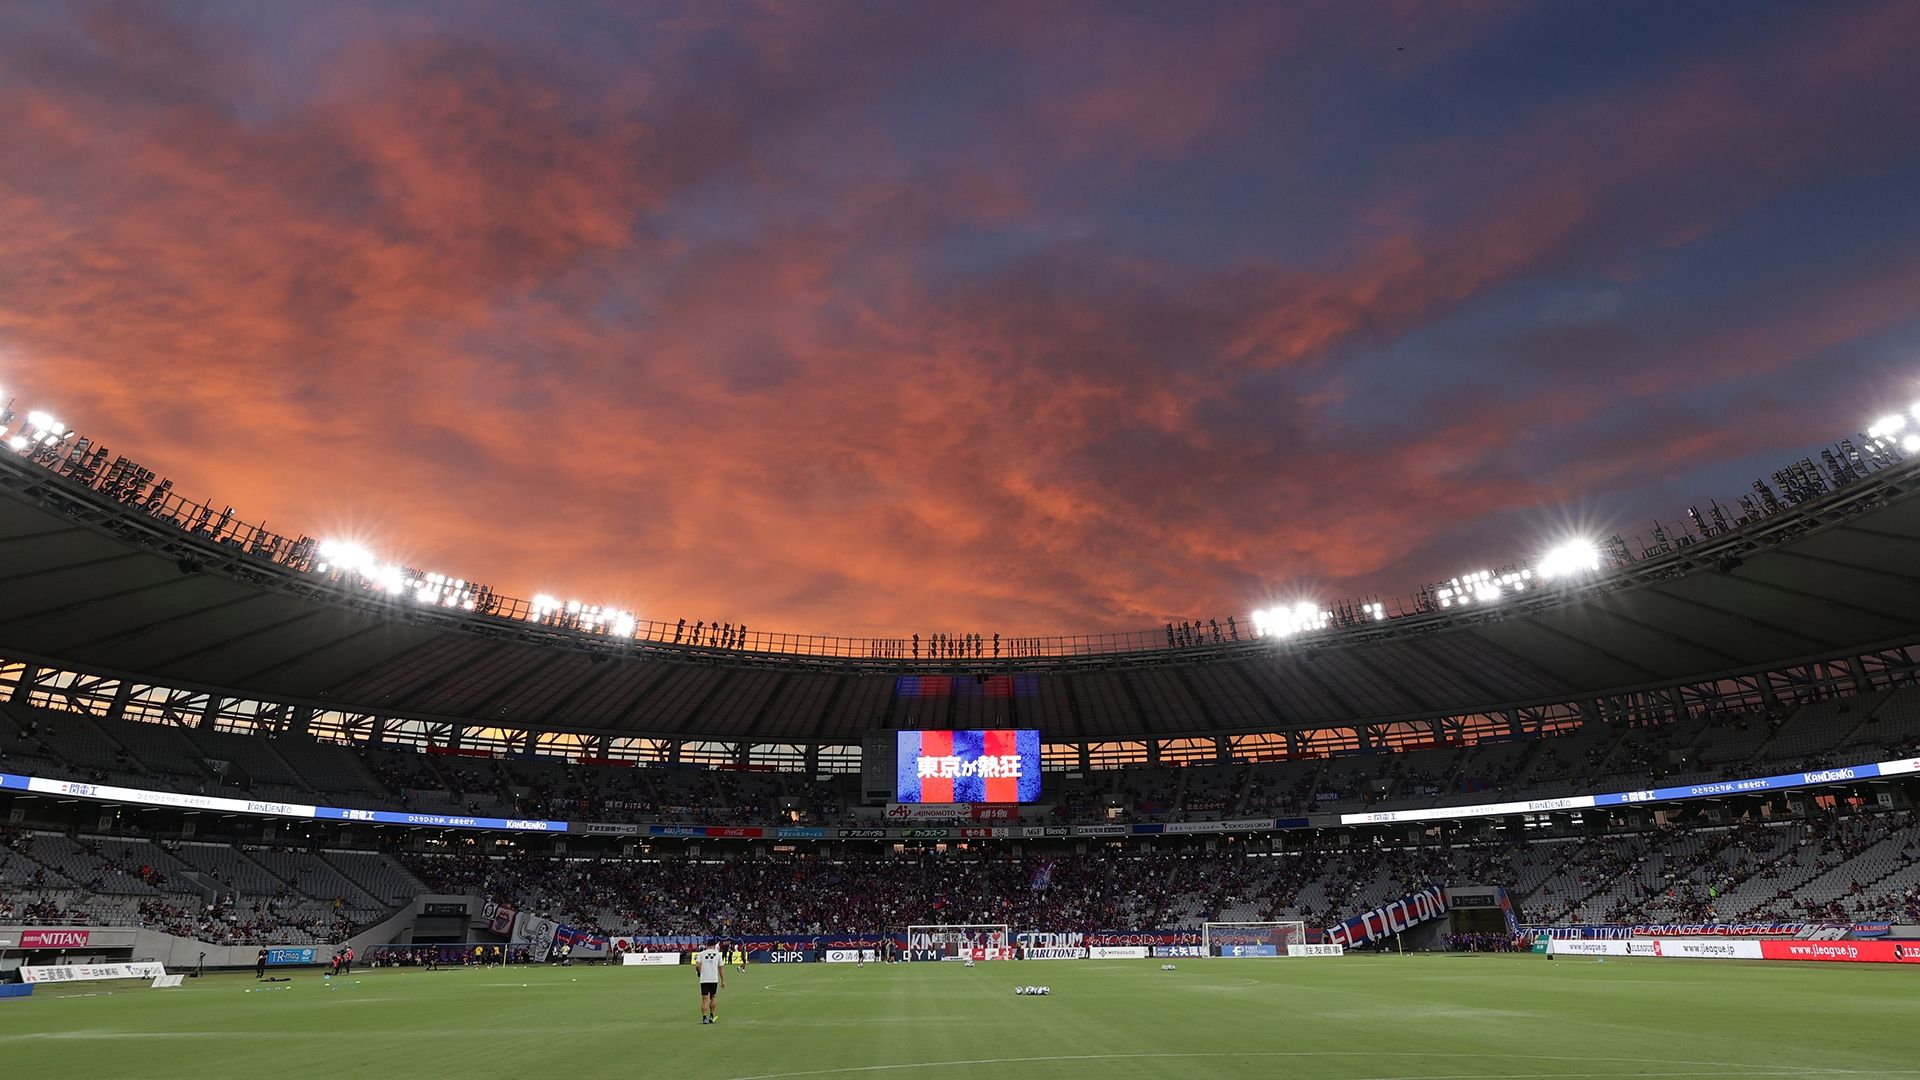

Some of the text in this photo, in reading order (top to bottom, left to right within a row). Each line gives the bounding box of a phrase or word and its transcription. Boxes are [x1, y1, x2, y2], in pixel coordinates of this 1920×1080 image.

[917, 755, 1022, 778] 東京が熱狂
[1879, 795, 1889, 803] 44
[1046, 827, 1067, 836] Blendy
[1361, 886, 1445, 942] CICLON
[39, 933, 83, 945] NITTAN
[1305, 946, 1341, 955] 住友商事
[1569, 943, 1607, 952] www.jleague.jp
[1683, 944, 1735, 956] www.jleague.jp
[1790, 944, 1858, 958] www.jleague.jp
[771, 952, 803, 963] SHIPS
